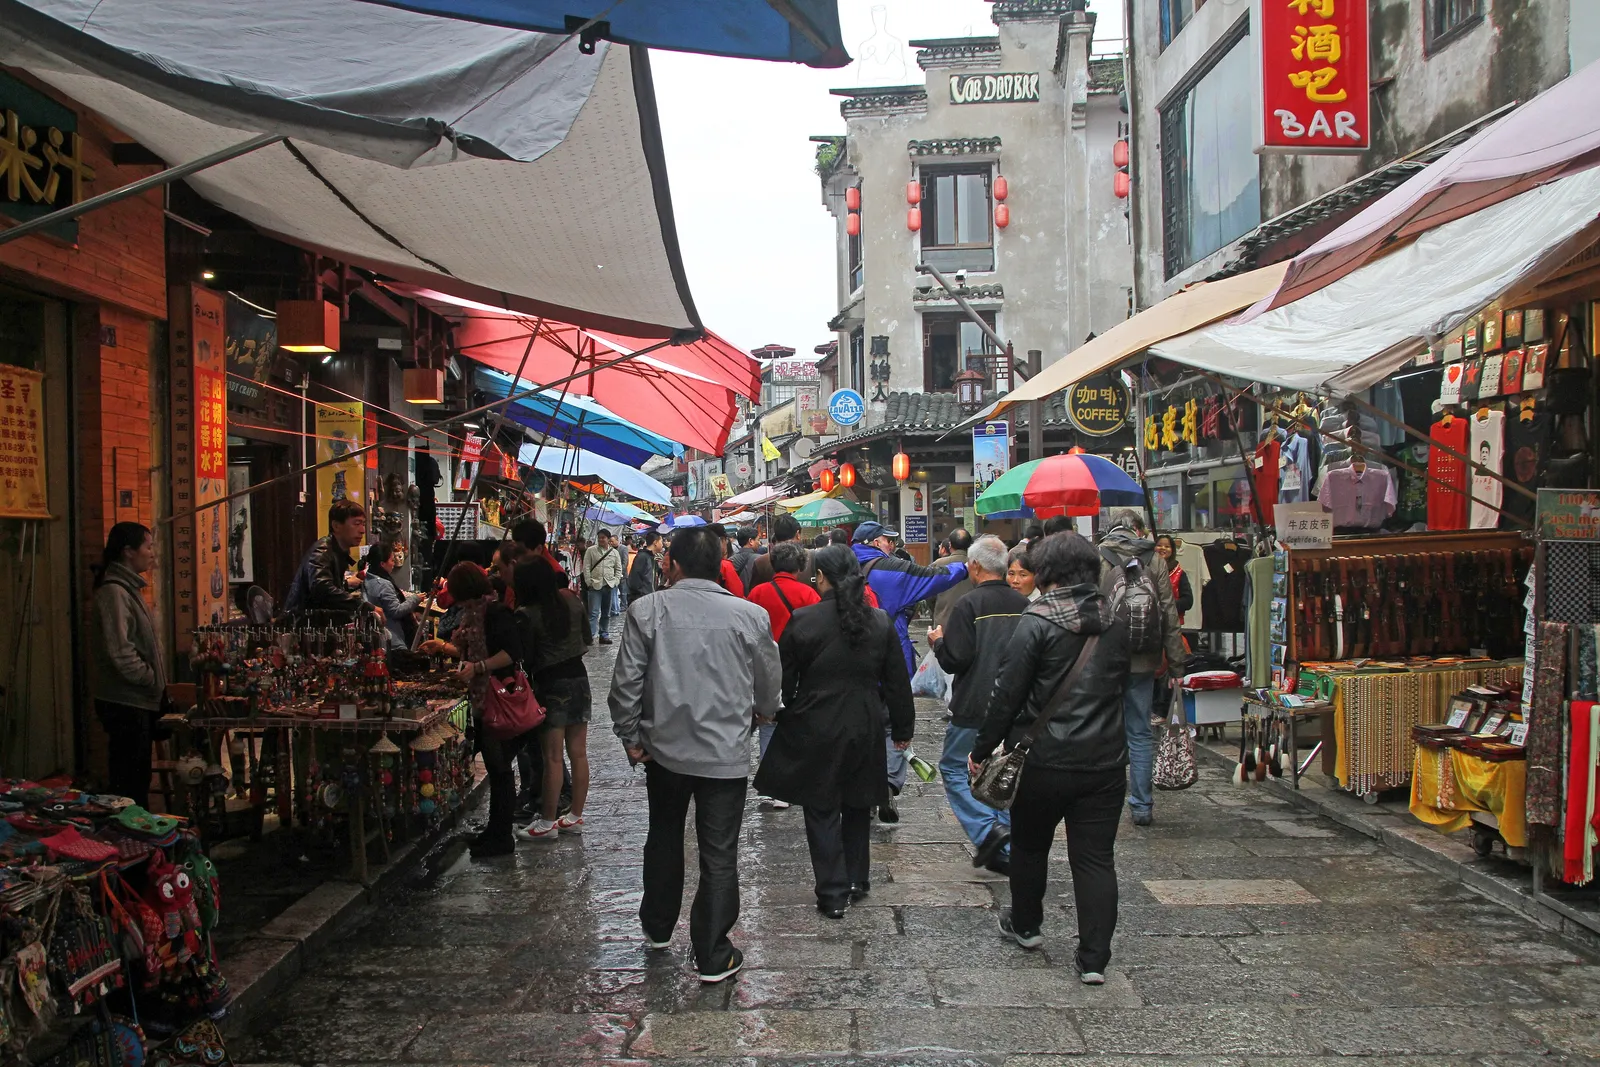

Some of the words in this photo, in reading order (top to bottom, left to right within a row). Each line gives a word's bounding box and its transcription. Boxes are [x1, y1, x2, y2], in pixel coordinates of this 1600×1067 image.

[1274, 109, 1361, 141] BAR
[239, 384, 260, 398] CRAFTS
[1077, 385, 1122, 406] 咖啡
[829, 404, 864, 414] LAVAZZA
[1077, 407, 1120, 421] COFFEE
[198, 373, 211, 472] 桂花香水
[212, 378, 223, 474] 阳朔特产
[1288, 519, 1330, 530] 牛皮皮带
[1555, 526, 1597, 538] Scarf
